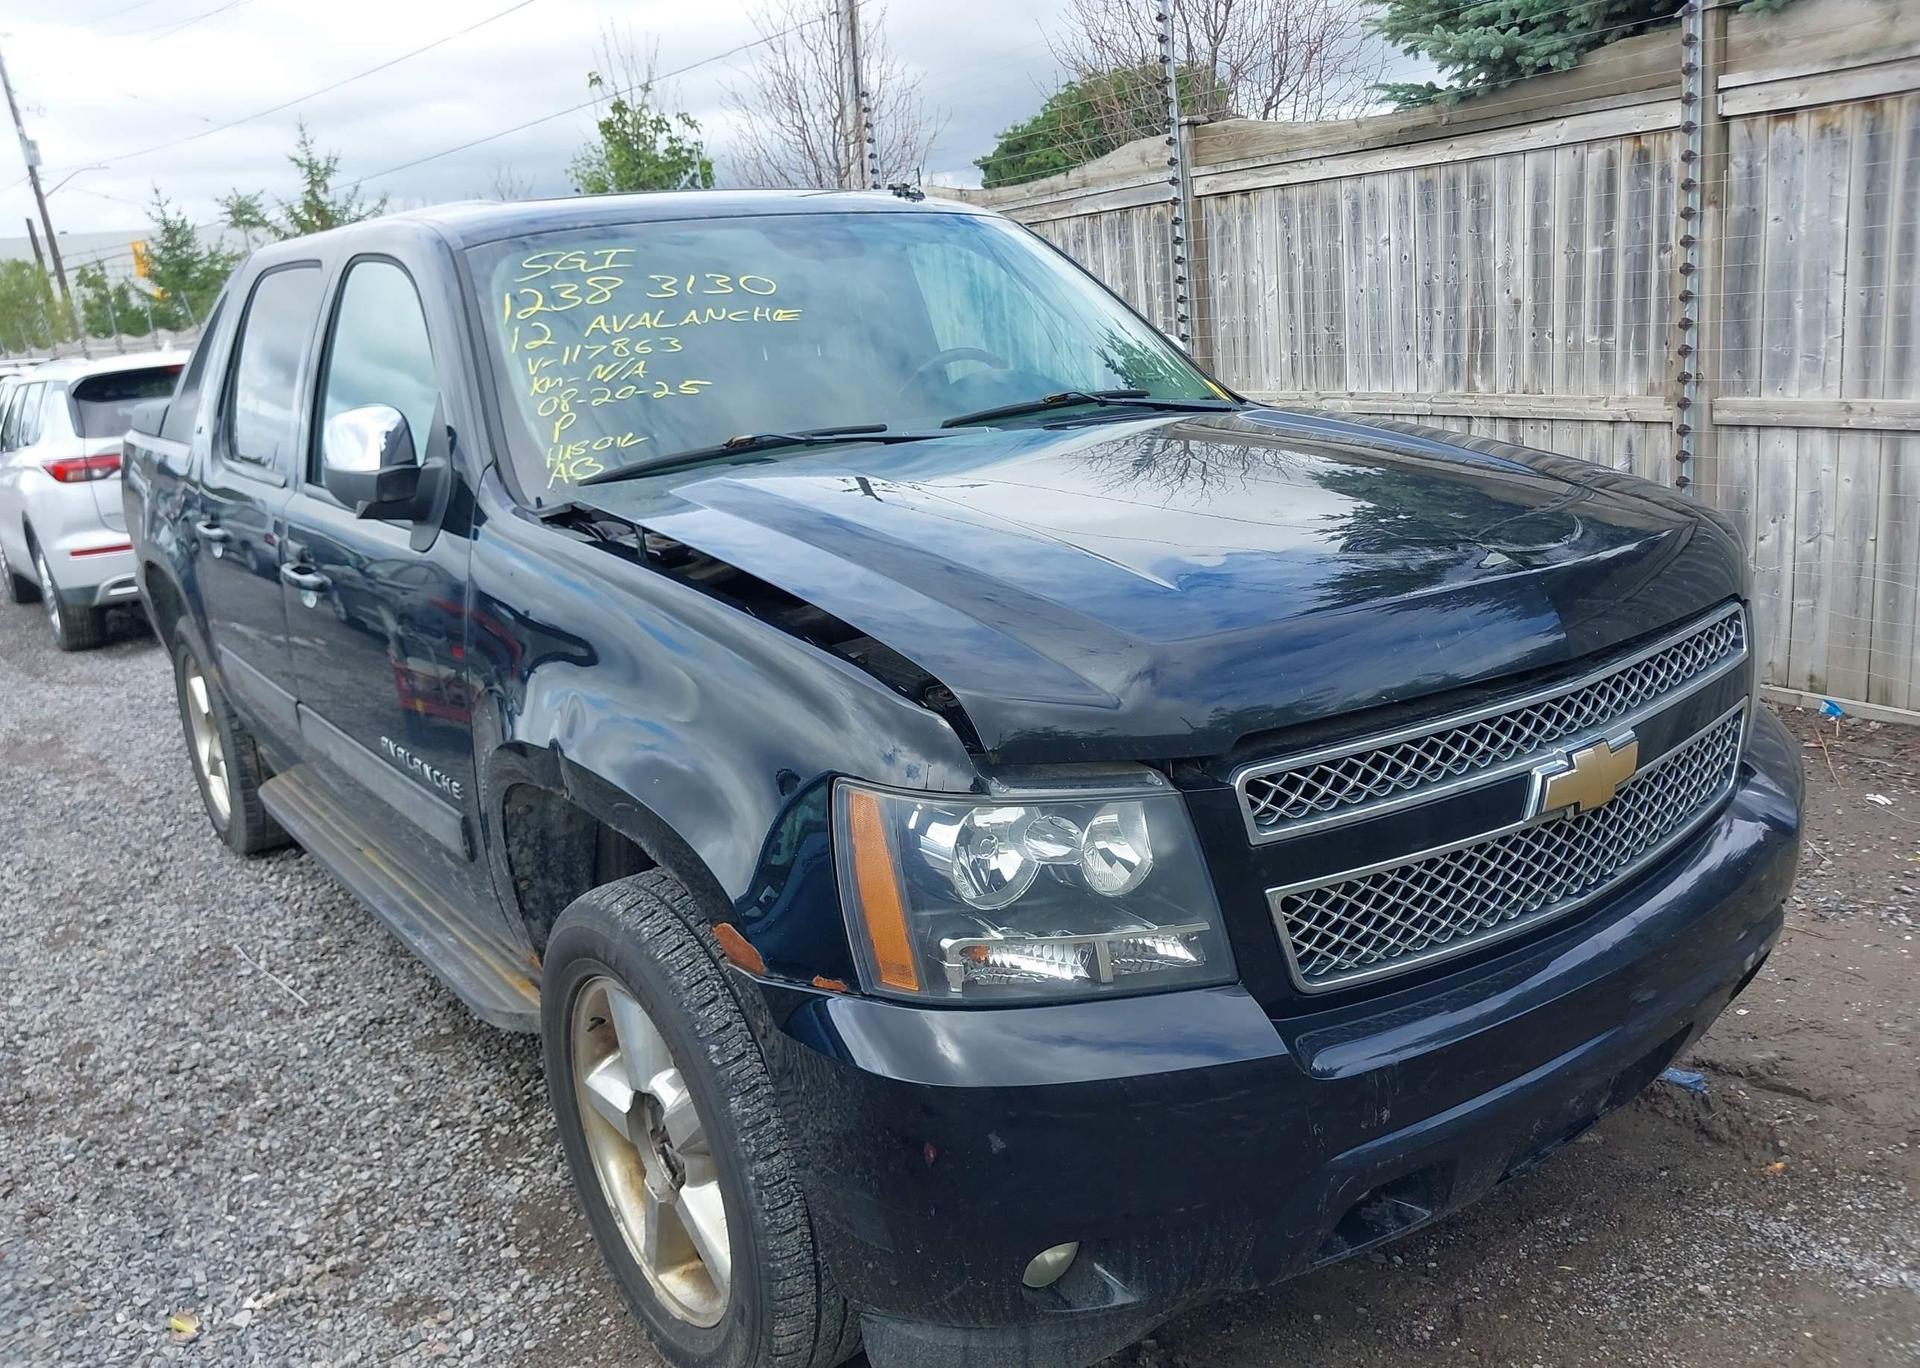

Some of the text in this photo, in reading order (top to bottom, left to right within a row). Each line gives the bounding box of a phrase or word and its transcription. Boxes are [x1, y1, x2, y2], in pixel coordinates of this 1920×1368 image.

[513, 248, 637, 283] SGI
[503, 273, 777, 324] 1238 3130
[511, 306, 802, 352] 12 AVALANCHE
[380, 735, 465, 800] AVALANCHE
